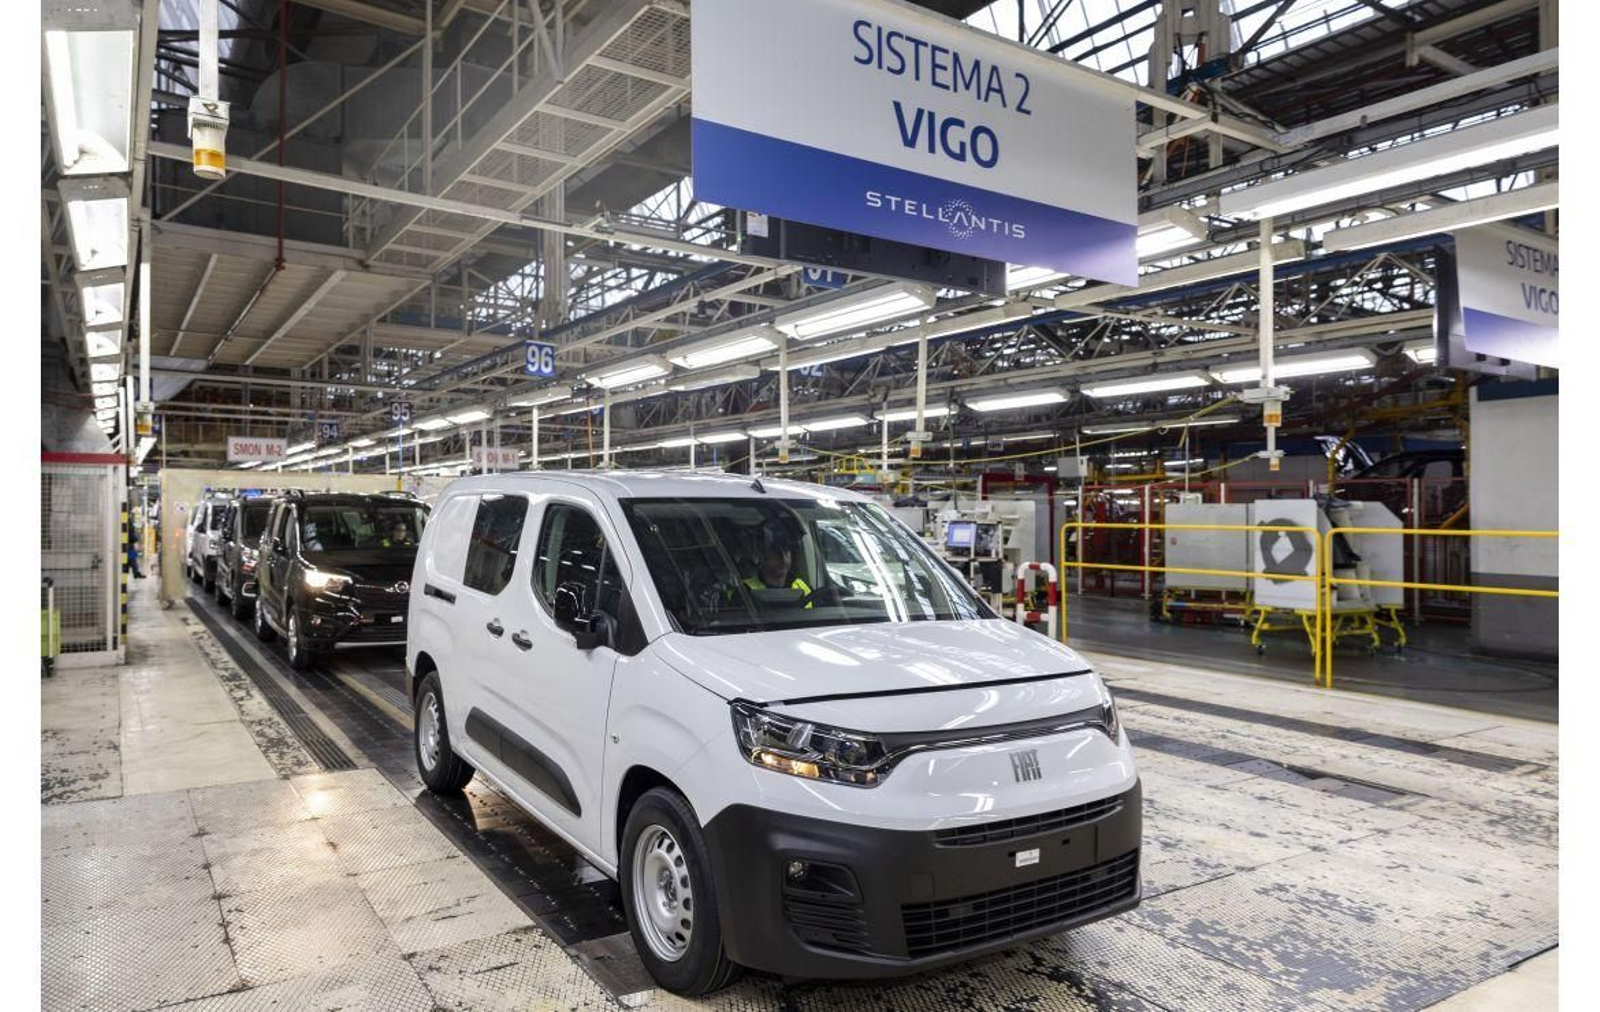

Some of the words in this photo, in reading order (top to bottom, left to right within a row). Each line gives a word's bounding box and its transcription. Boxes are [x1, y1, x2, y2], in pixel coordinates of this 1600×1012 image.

[852, 19, 1007, 109] SISTEMA
[1015, 72, 1033, 116] 2
[892, 99, 1000, 169] VIGO
[865, 190, 1026, 239] STELLANTIS
[1521, 282, 1559, 316] VIGO
[527, 345, 553, 374] 96
[391, 402, 410, 421] 95
[322, 424, 339, 439] 94
[232, 442, 262, 457] SMON
[266, 443, 283, 457] M-2
[1008, 749, 1042, 783] FIAT
